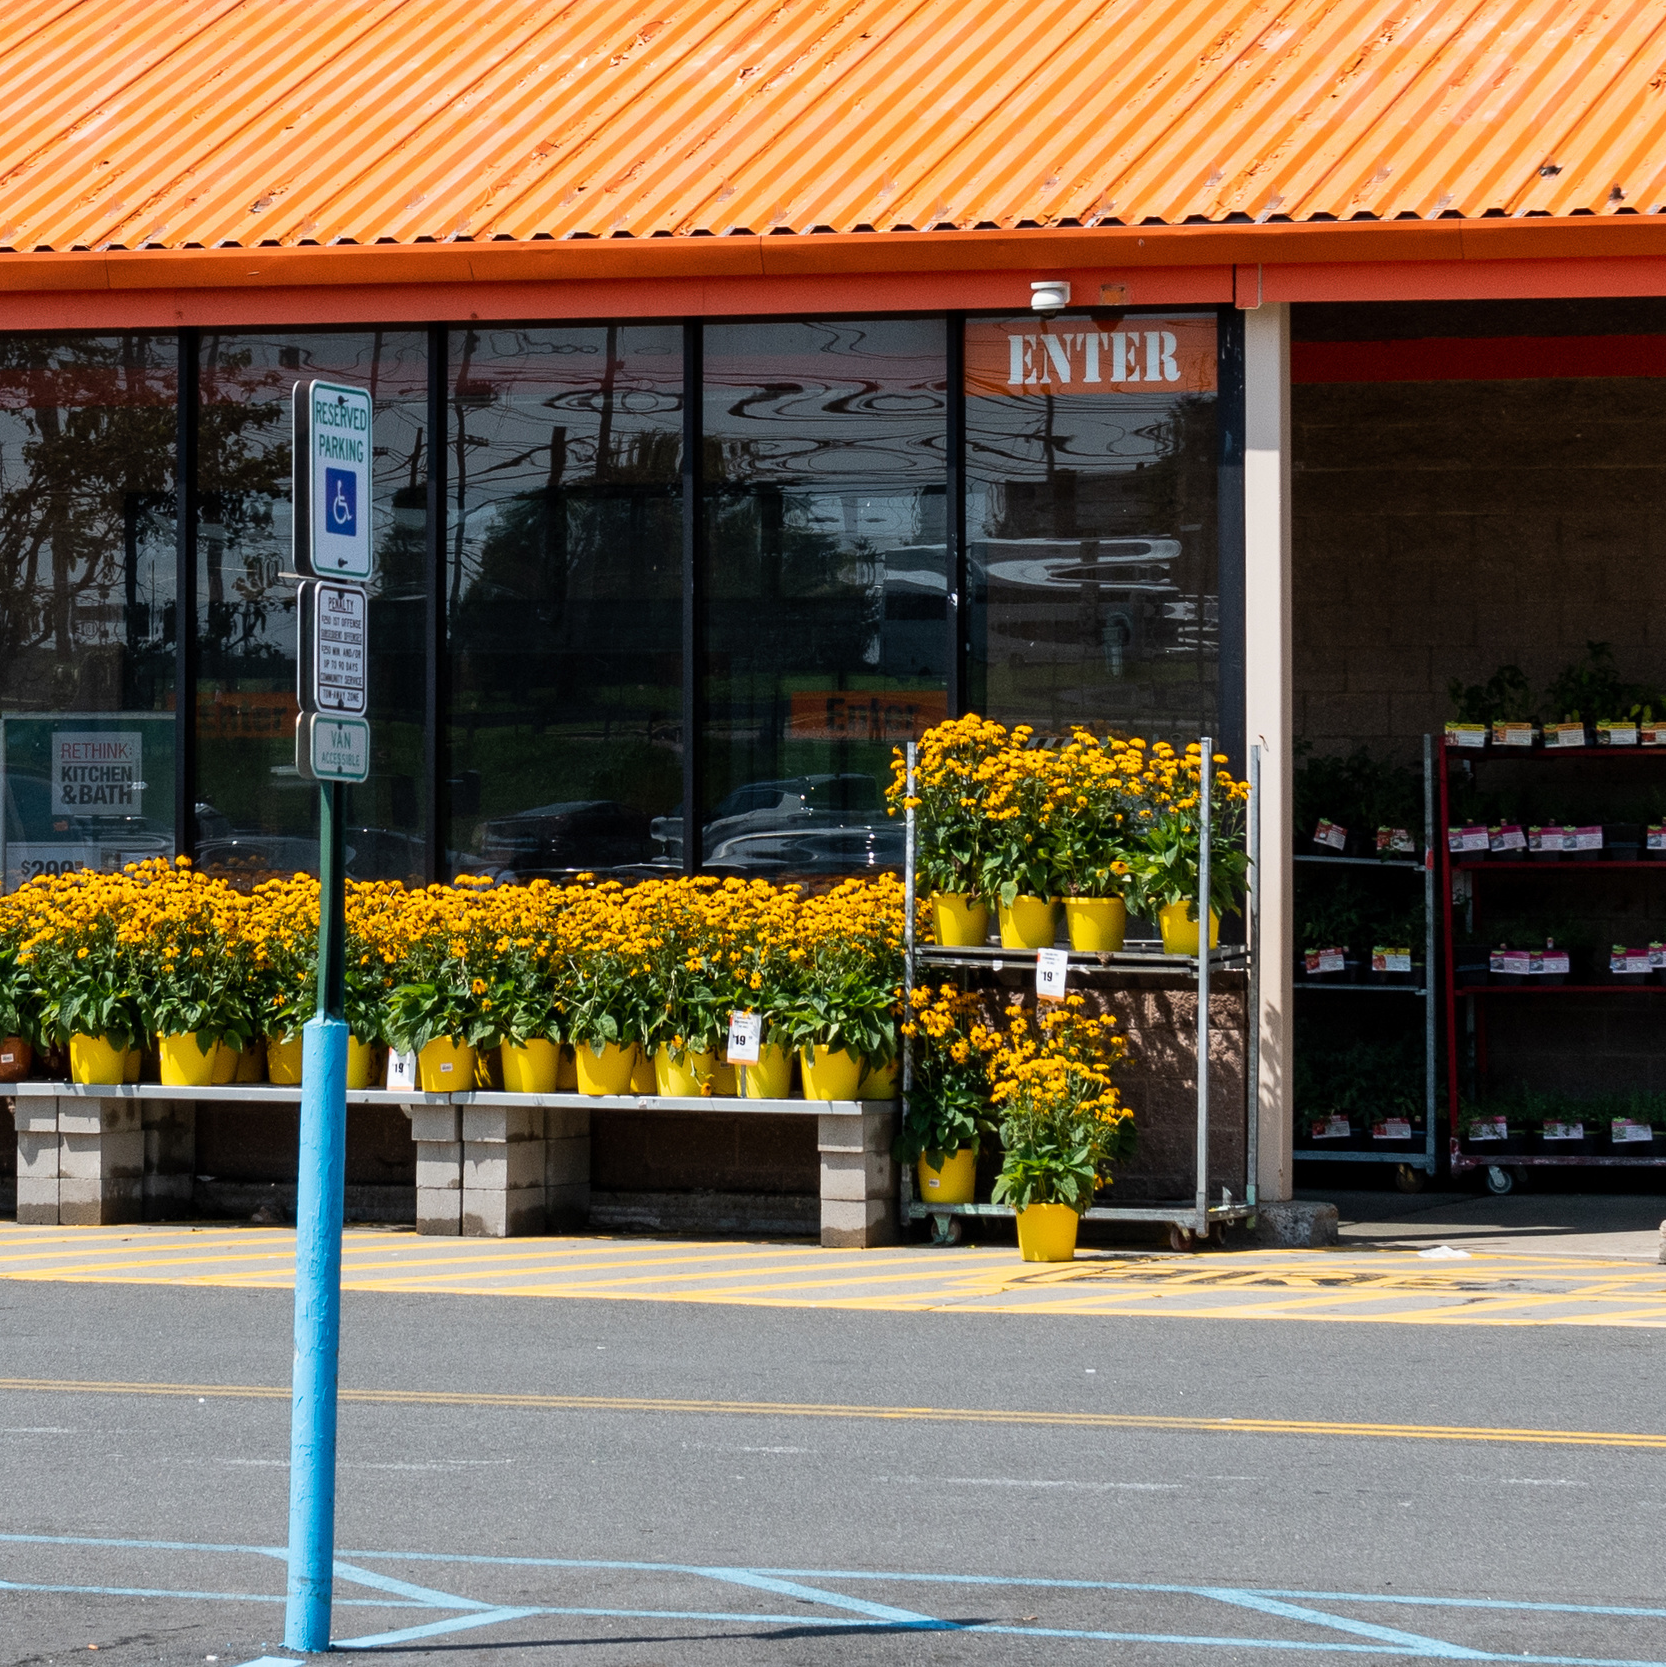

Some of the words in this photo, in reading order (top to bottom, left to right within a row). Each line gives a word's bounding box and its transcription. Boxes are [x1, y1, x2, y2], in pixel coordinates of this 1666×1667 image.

[1007, 331, 1181, 384] ENTER
[315, 400, 367, 431] RESERVED
[319, 434, 364, 463] PARKING
[341, 617, 361, 629] OFFENSE
[323, 659, 330, 668] UP
[331, 660, 337, 669] TO
[338, 661, 345, 670] 90
[346, 662, 358, 672] DAYS
[344, 675, 362, 687] SERVICE
[347, 691, 359, 702] ZONE
[331, 731, 351, 750] VAN
[61, 742, 133, 759] RETHINK:
[322, 751, 360, 767] ACCESSIBLE
[61, 766, 133, 782] KITCHEN
[1023, 1267, 1500, 1291] FIRE
